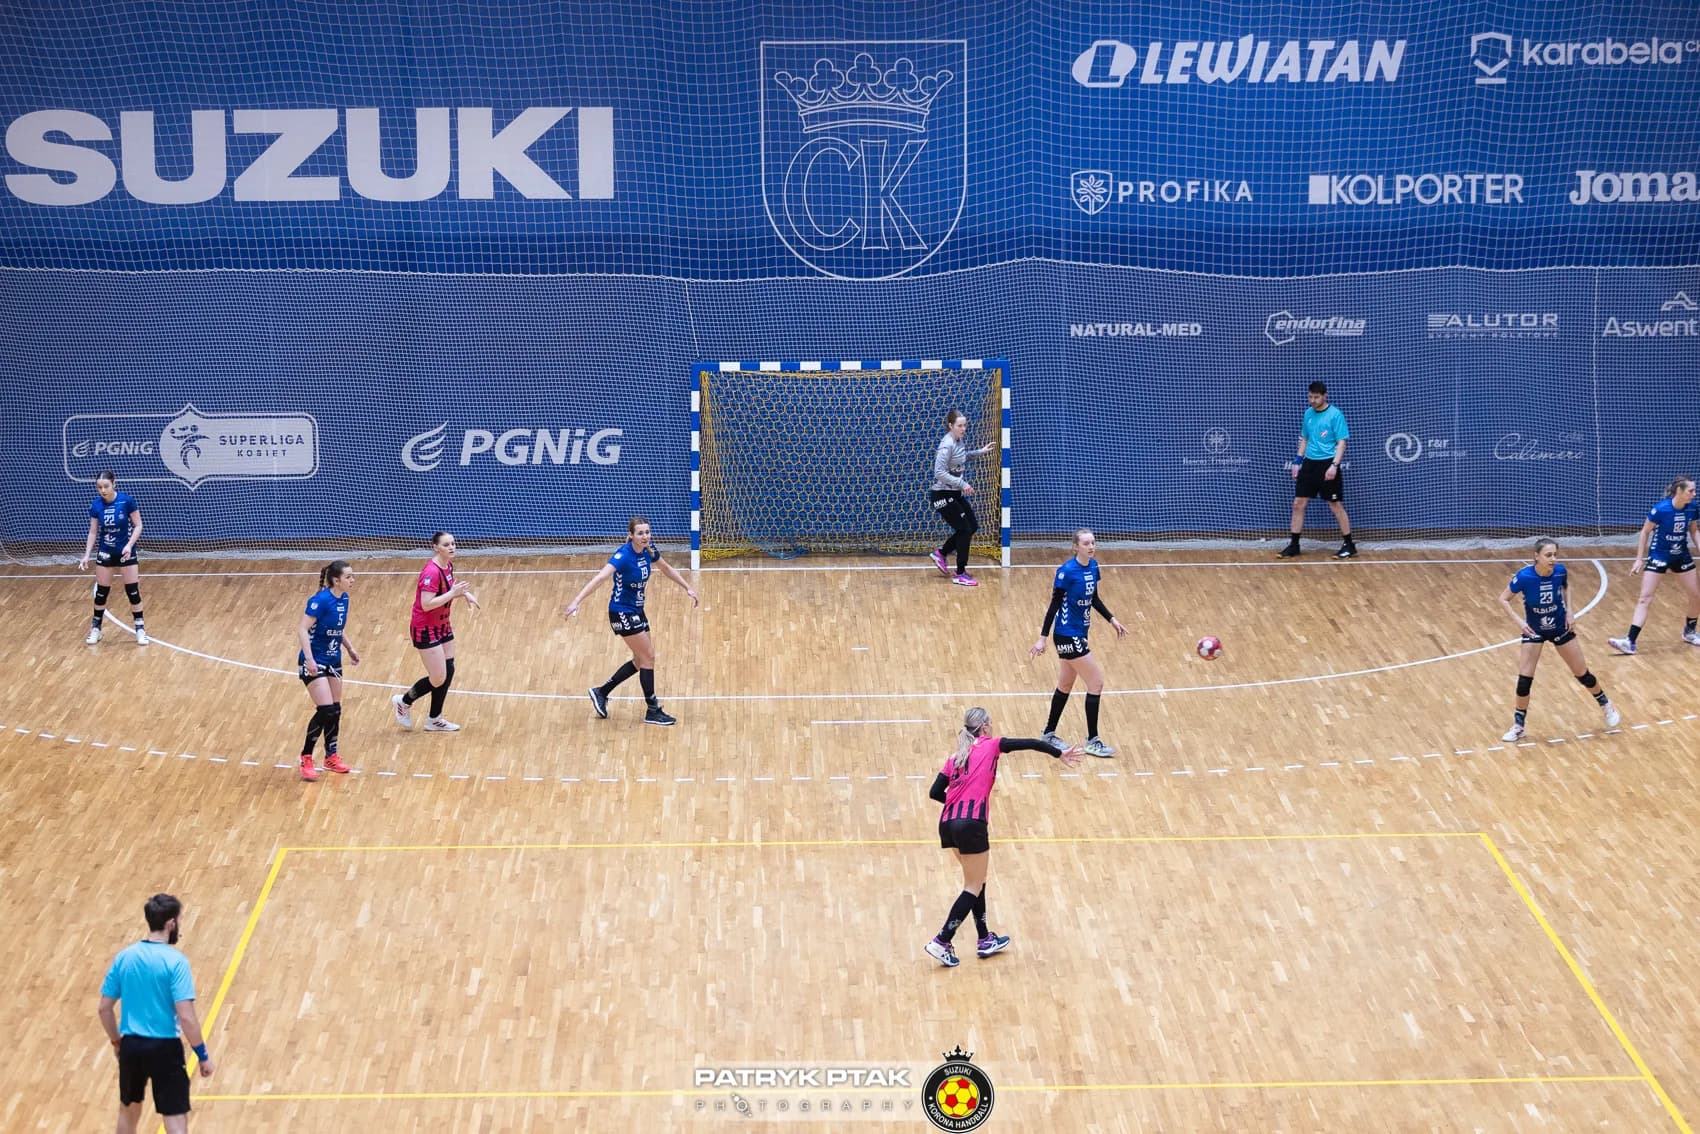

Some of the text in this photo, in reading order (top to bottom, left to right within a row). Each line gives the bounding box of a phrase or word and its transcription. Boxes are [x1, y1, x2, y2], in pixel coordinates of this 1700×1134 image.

[1140, 34, 1406, 84] LEWIATAN
[1523, 36, 1682, 65] karabela
[5, 106, 614, 206] SUZUKI
[784, 136, 928, 251] CK
[1118, 180, 1253, 203] PROFIKA
[1330, 173, 1524, 205] KOLPORTER
[1569, 170, 1700, 205] Joma
[1275, 316, 1366, 331] endorfina
[1446, 313, 1558, 327] ALUTOR
[1070, 323, 1202, 337] NATURAL-MED
[94, 441, 154, 456] PGNiG
[218, 434, 305, 446] SUPERLIGA
[460, 428, 623, 465] PGNiG
[237, 449, 287, 457] KOBIET
[104, 514, 116, 526] 22
[1539, 591, 1554, 604] 23
